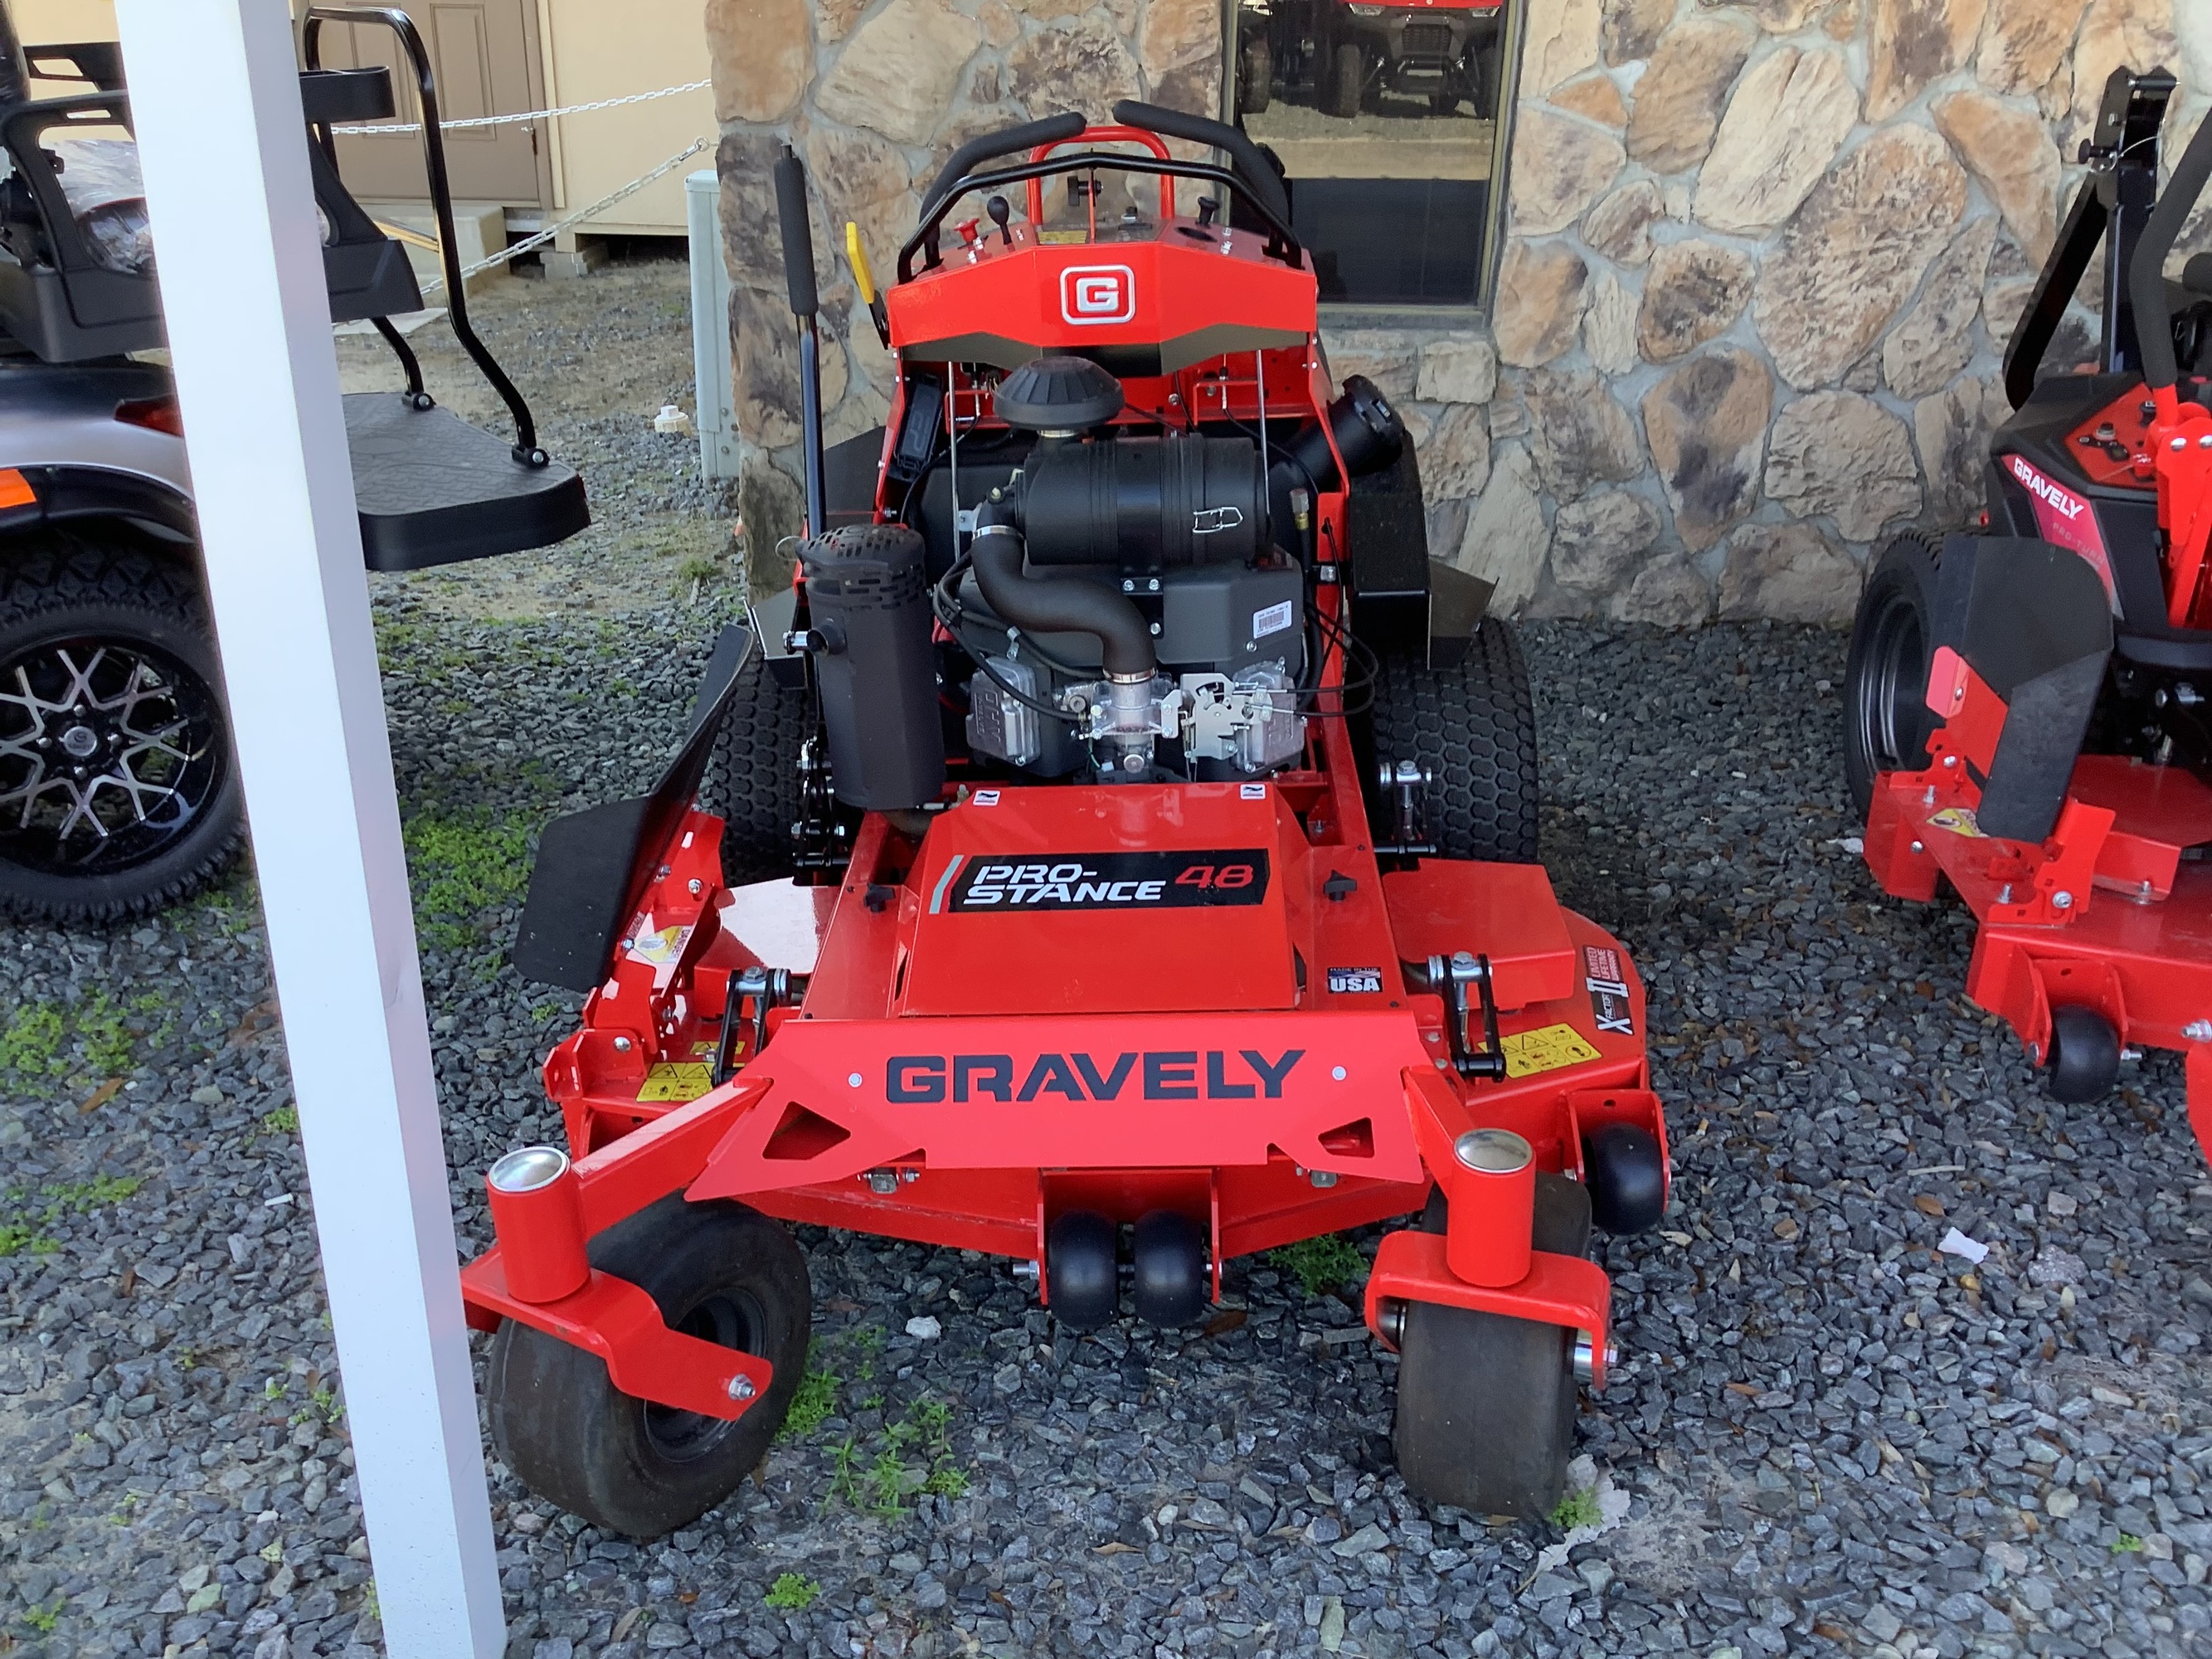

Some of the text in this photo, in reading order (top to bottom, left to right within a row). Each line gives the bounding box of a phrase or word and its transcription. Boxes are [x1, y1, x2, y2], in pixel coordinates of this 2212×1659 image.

[1076, 277, 1119, 313] G
[2014, 457, 2084, 519] GRAVELY
[973, 864, 1097, 884] PRO-
[1174, 864, 1254, 888] 48
[963, 880, 1167, 904] STANCE
[1587, 946, 1601, 978] LIMITED
[1597, 948, 1611, 980] LIFETIME
[1330, 978, 1380, 992] USA
[886, 1049, 1306, 1103] GRAVELY
